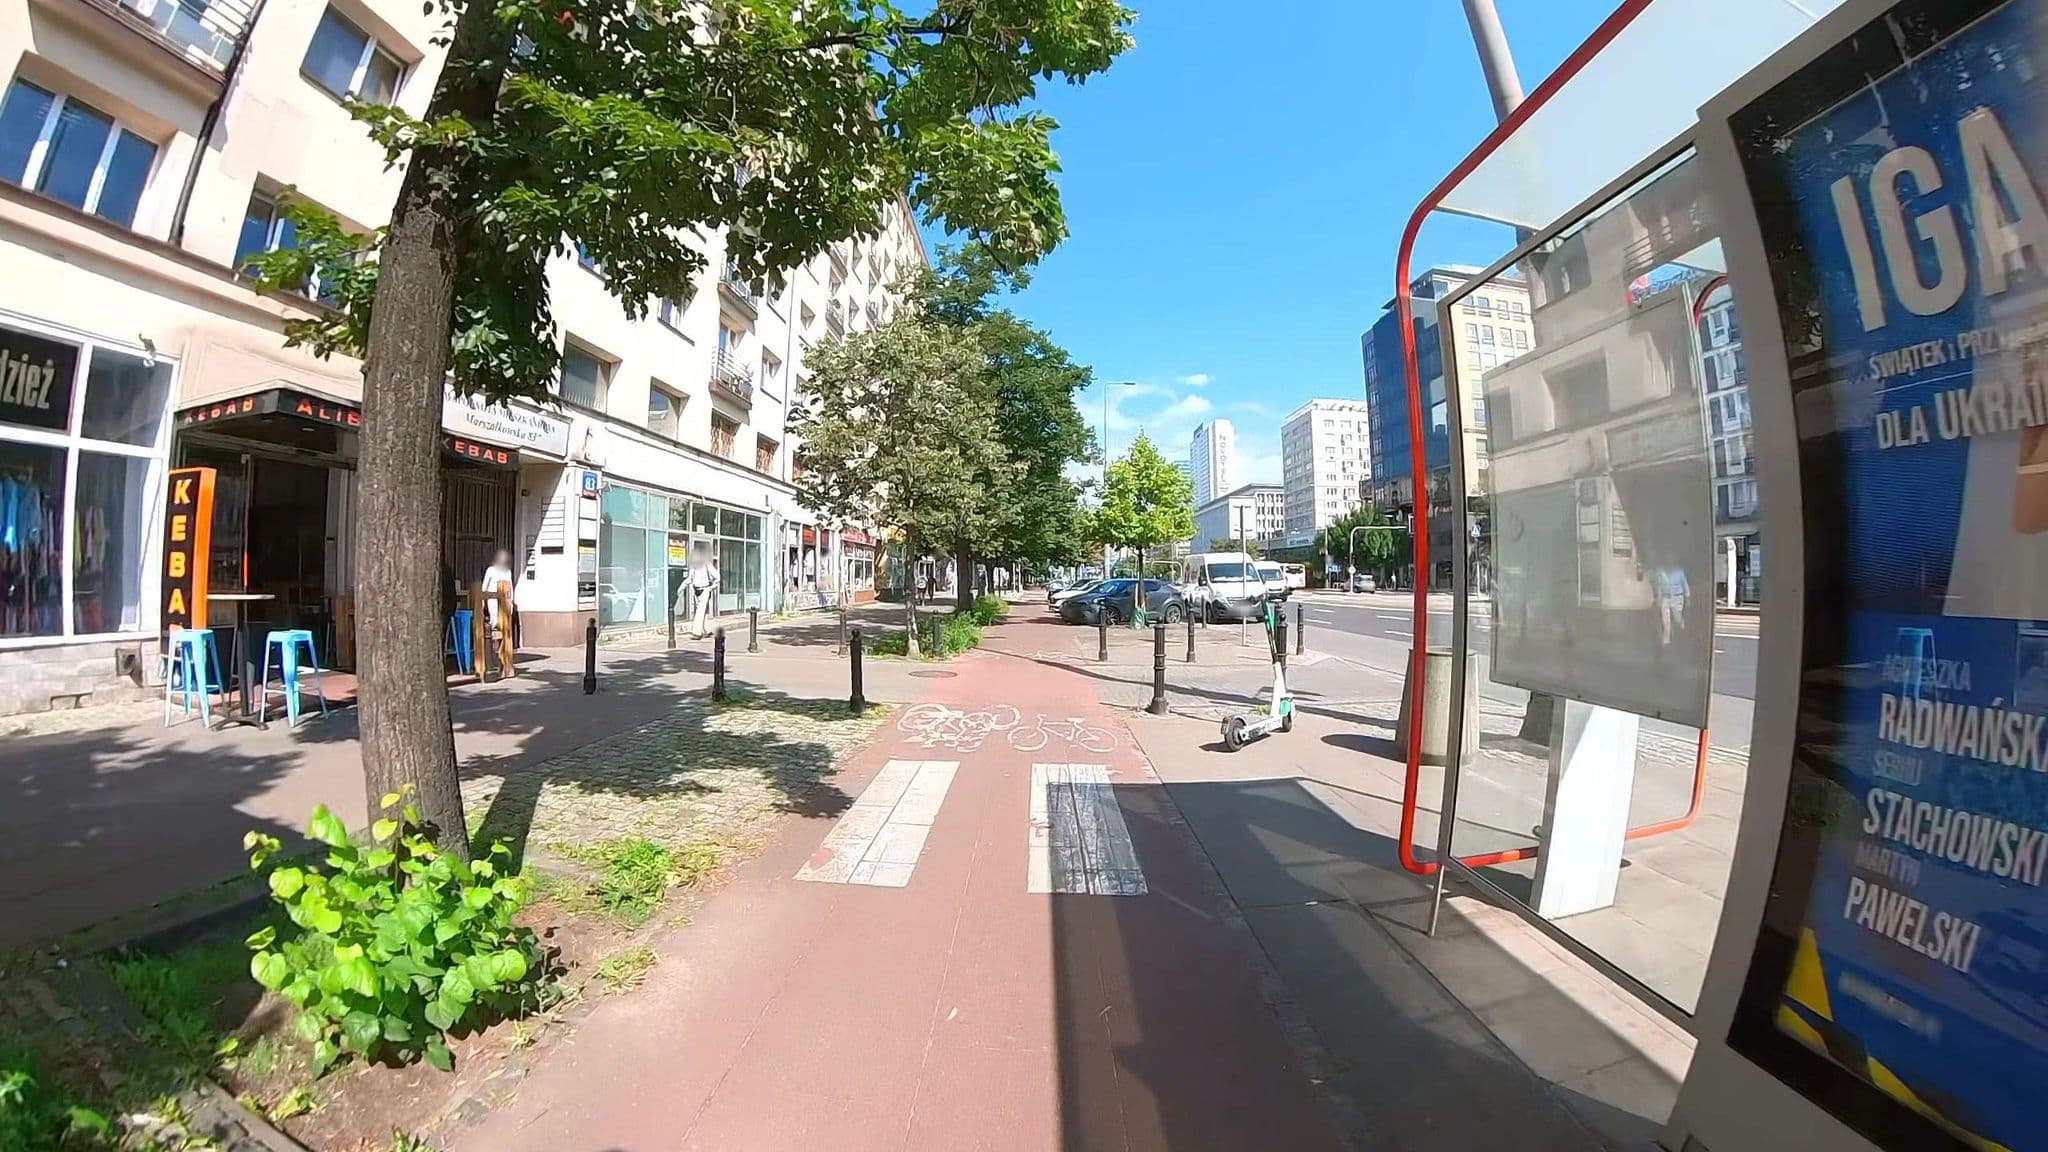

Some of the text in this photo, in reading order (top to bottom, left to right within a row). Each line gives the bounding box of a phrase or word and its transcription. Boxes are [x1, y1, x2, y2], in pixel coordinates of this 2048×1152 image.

[1831, 105, 2048, 331] IGA
[1869, 338, 1947, 380] ŚWIĄTEK
[442, 438, 509, 464] KEBAB
[1876, 405, 1931, 450] DLA
[585, 477, 597, 491] 83
[167, 478, 193, 631] KEBA
[1879, 693, 2048, 773] RADWAŃSK
[1862, 787, 2048, 887] STACHOWSKI
[1844, 876, 1983, 974] PAWELSKI
